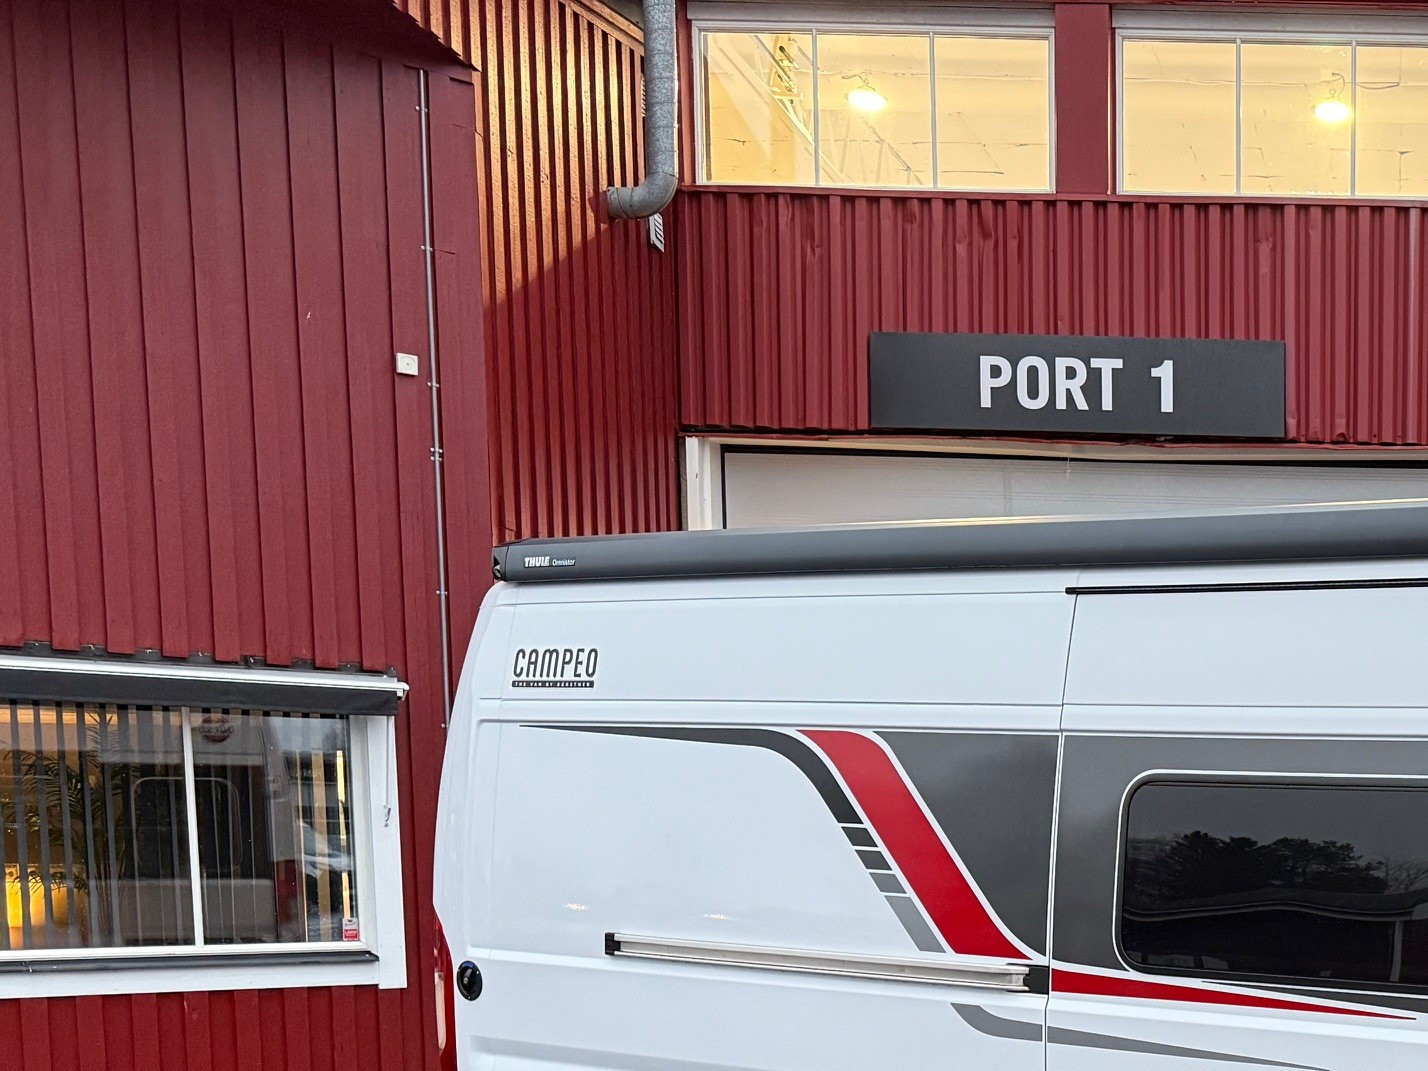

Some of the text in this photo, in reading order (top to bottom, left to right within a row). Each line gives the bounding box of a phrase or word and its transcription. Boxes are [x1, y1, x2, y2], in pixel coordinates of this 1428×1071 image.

[979, 355, 1174, 413] PORT 1
[524, 556, 550, 567] THULE
[513, 648, 598, 678] CAMPEO
